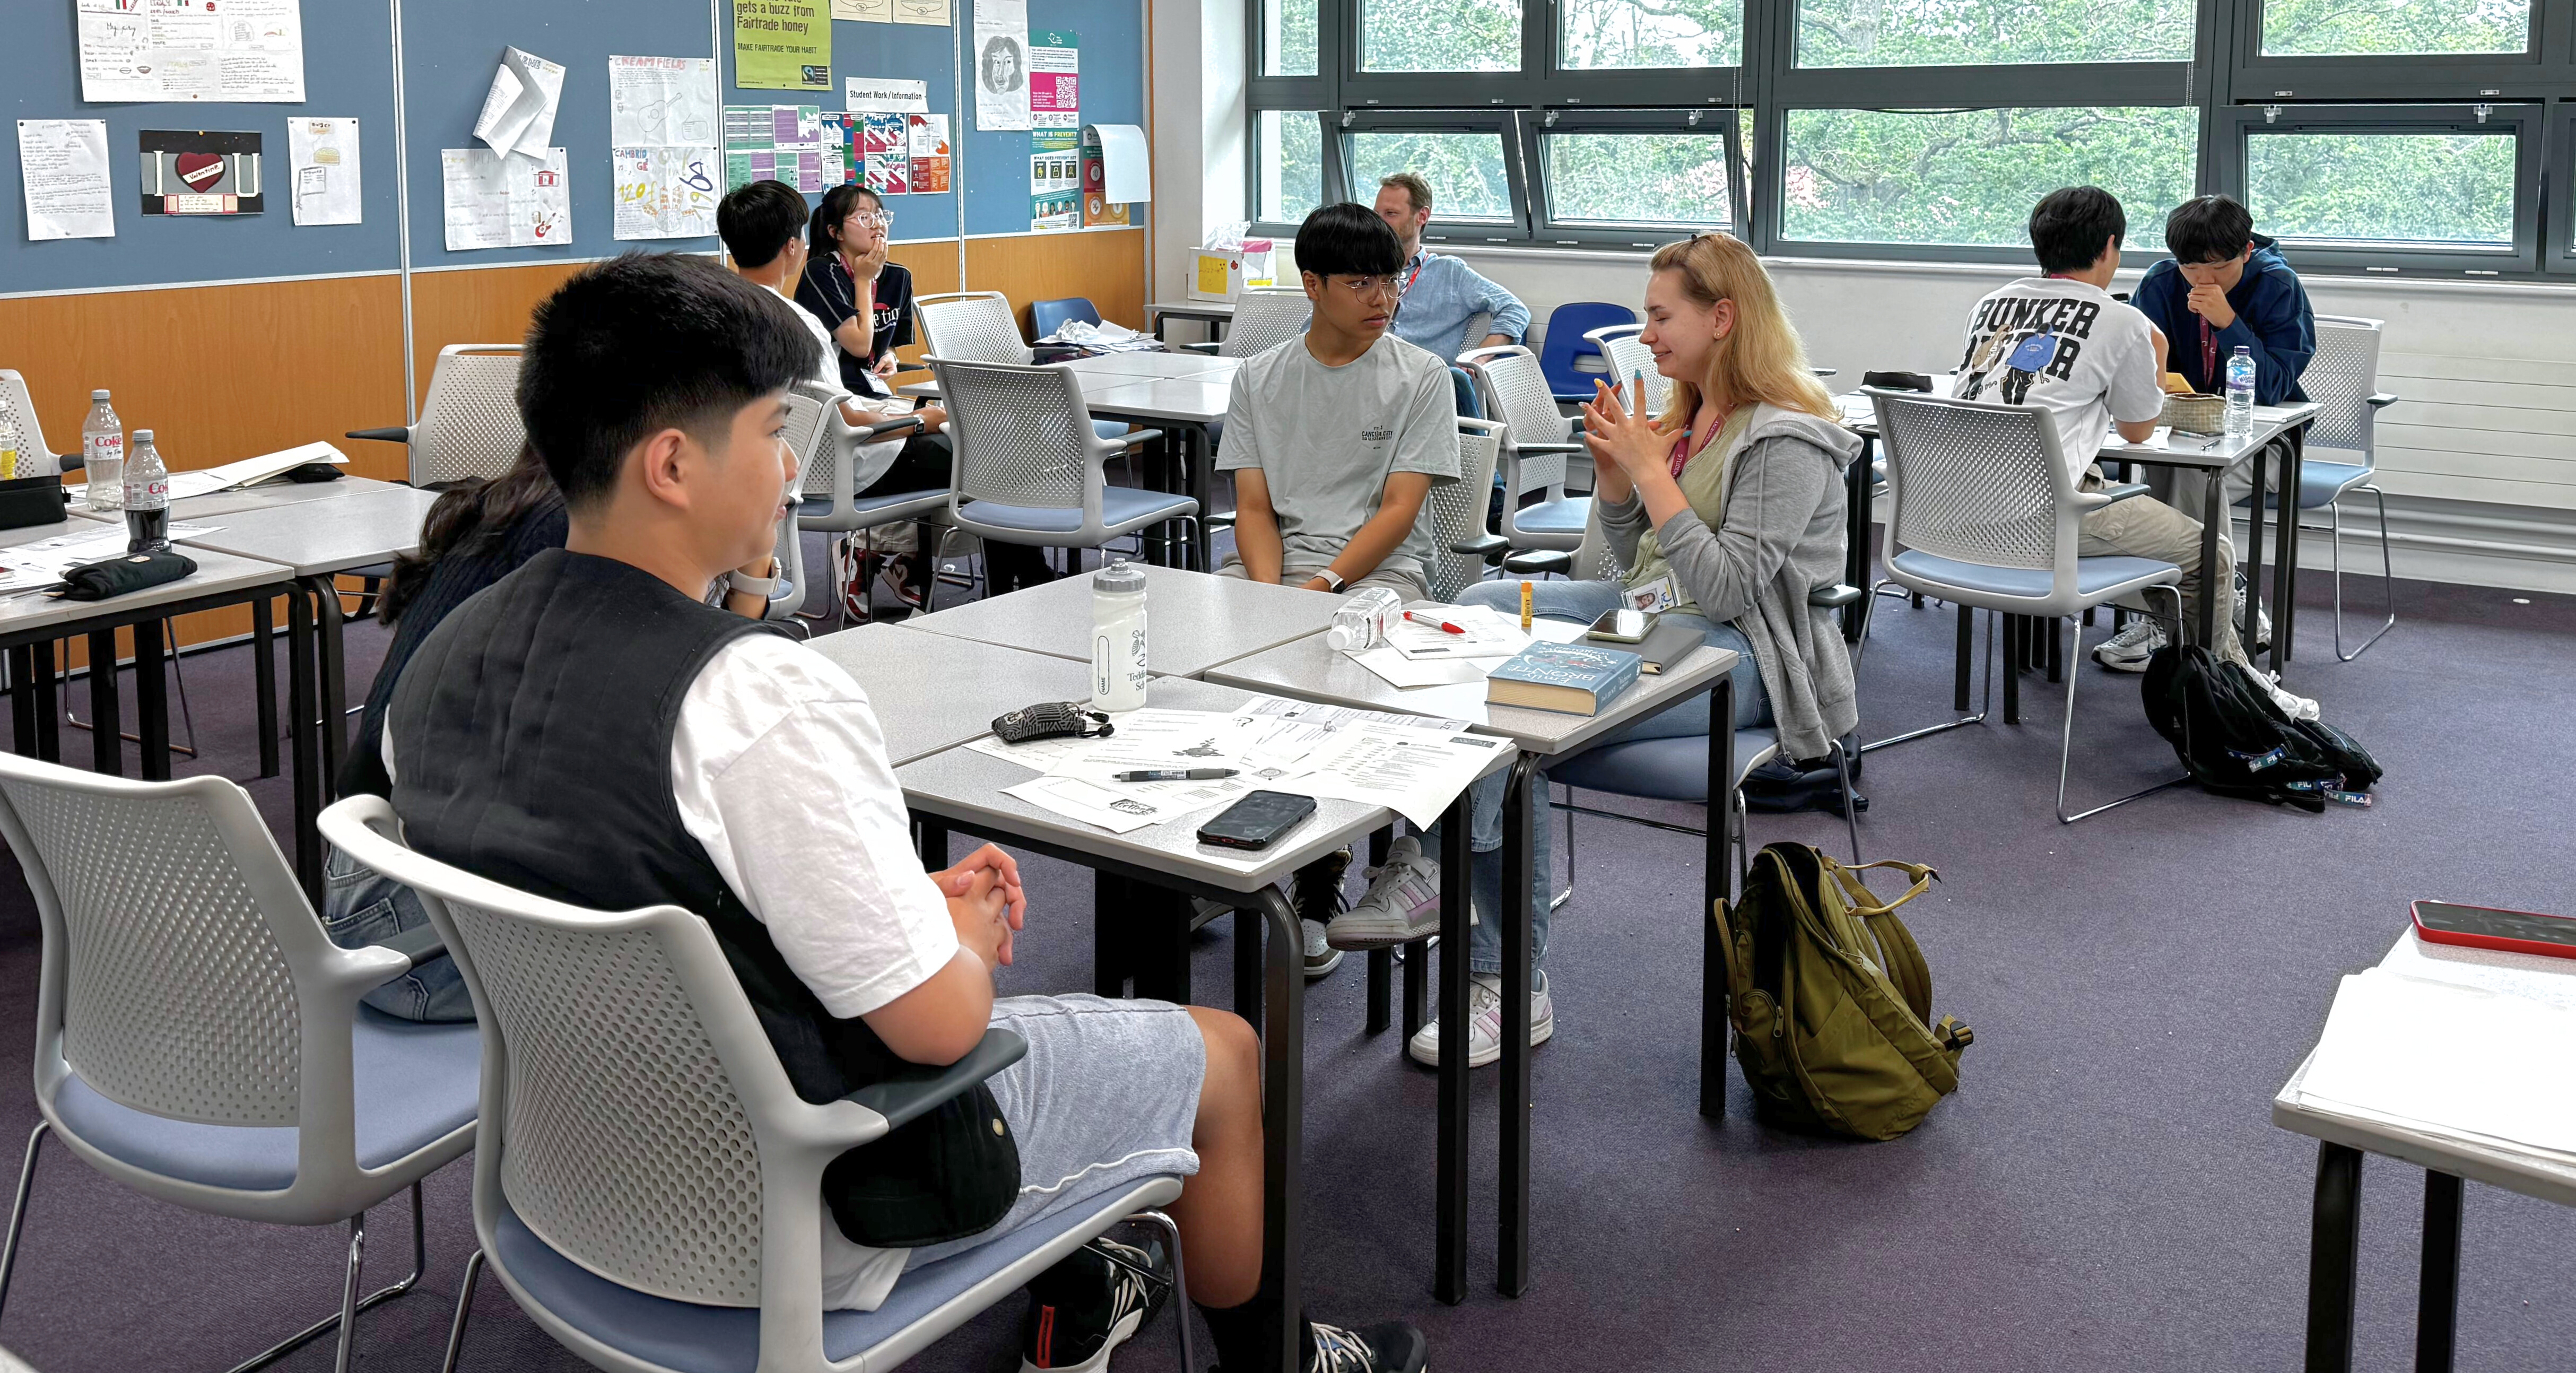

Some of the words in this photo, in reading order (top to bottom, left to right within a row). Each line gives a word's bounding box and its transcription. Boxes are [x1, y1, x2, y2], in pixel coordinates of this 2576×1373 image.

[737, 1, 757, 15] gets
[761, 4, 766, 13] a
[769, 2, 790, 14] buzz
[794, 5, 814, 17] from
[737, 16, 779, 31] Fairtrade
[782, 19, 808, 36] honey
[755, 44, 784, 53] FAIRTRADE
[614, 57, 655, 66] CREAM
[657, 58, 686, 70] FIELDS
[153, 151, 164, 196] I
[189, 164, 220, 180] Valentine
[232, 153, 259, 197] U
[1971, 298, 2101, 340] BUNKER
[95, 436, 122, 447] Coke
[1522, 672, 1570, 684] Emily
